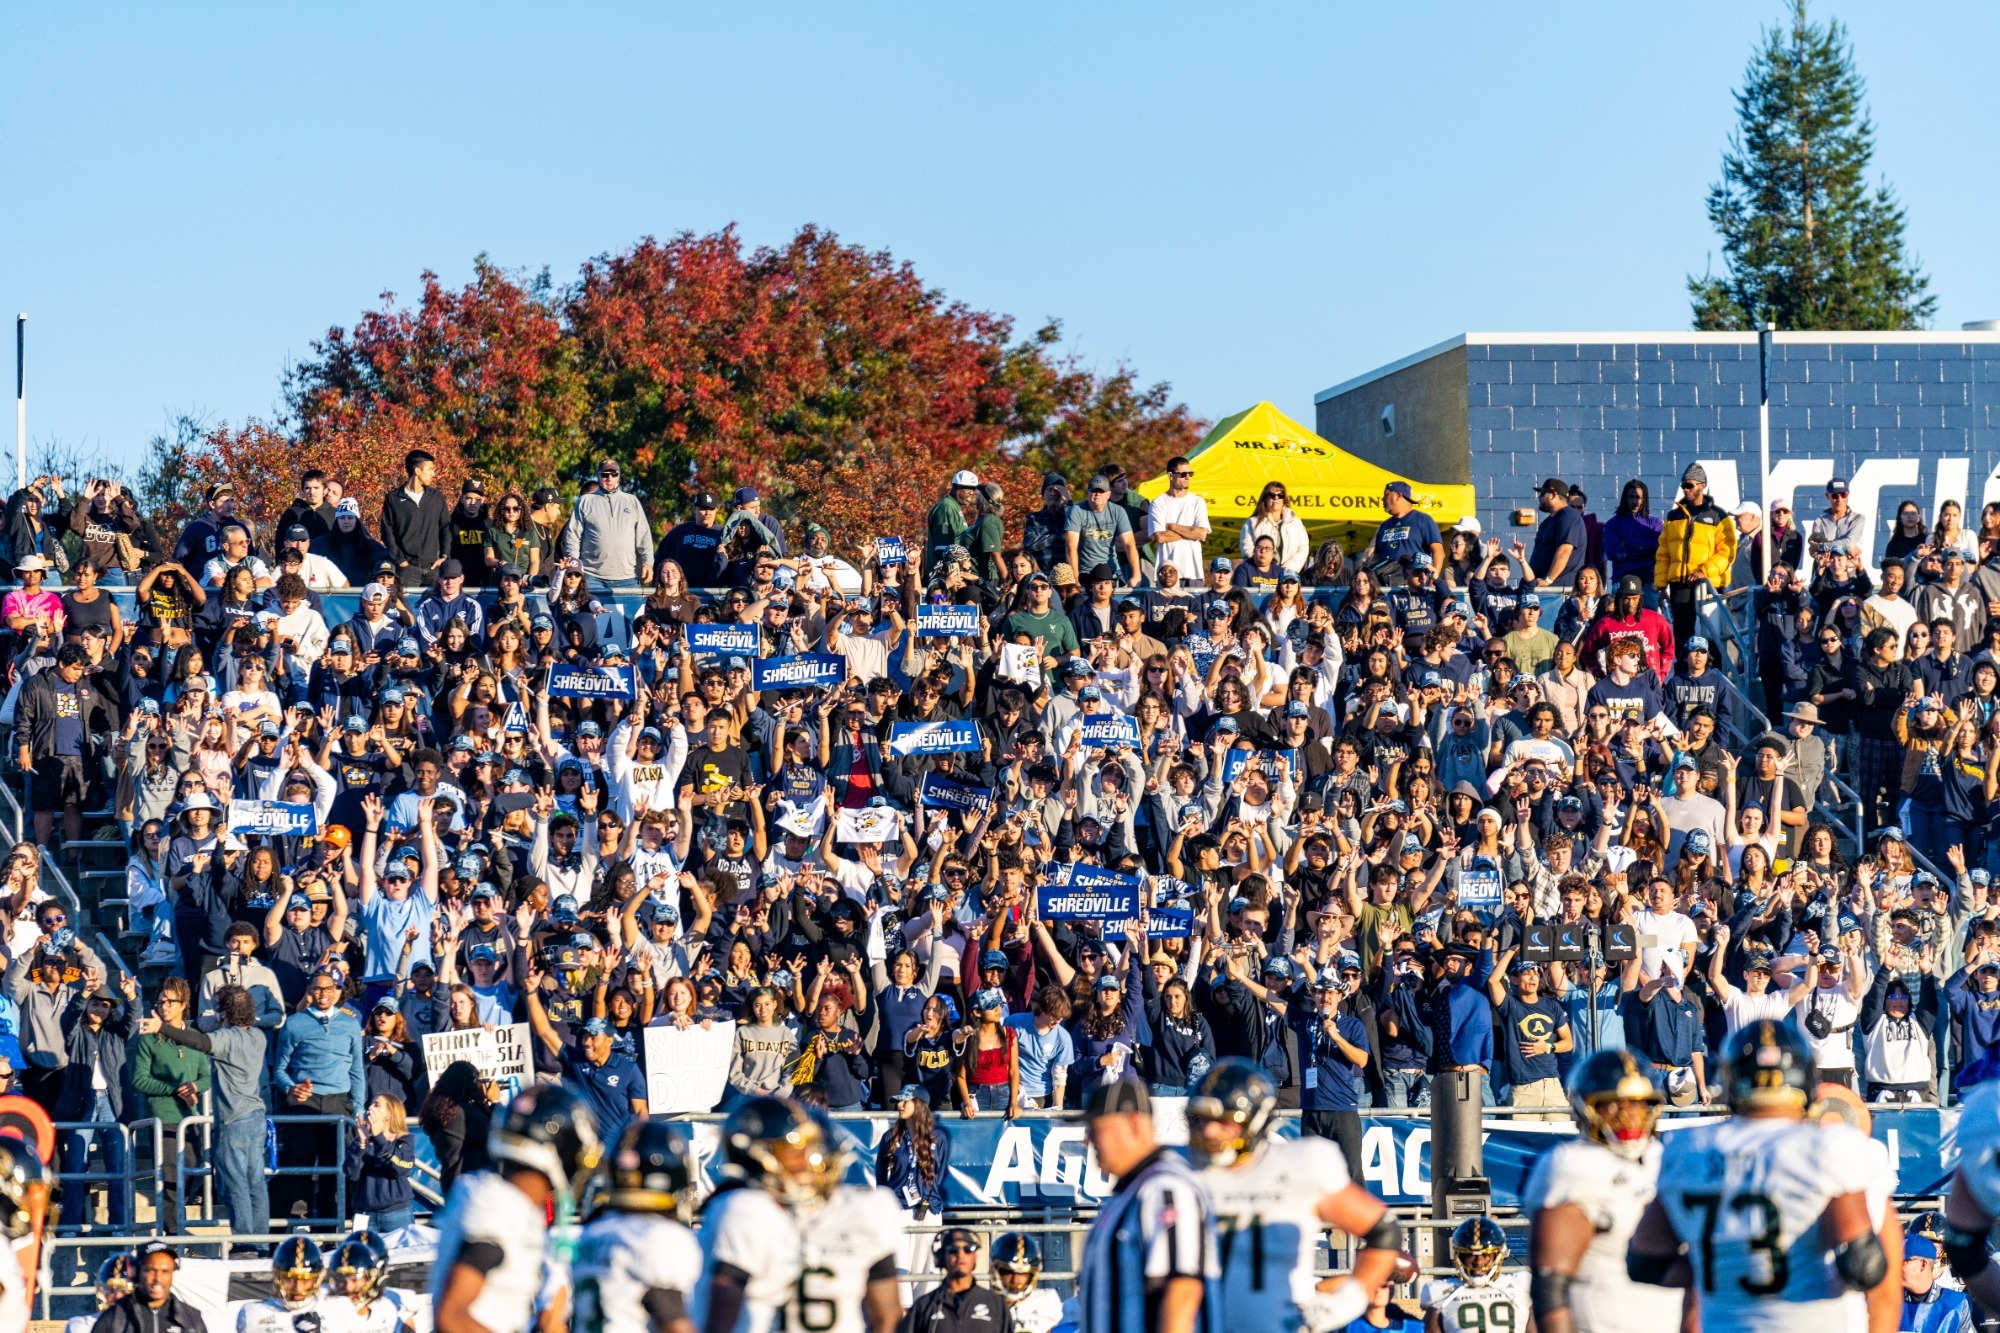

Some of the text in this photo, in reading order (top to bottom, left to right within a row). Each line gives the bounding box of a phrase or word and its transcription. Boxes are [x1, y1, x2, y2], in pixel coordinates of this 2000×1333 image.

[1234, 495, 1325, 508] CAMEL
[458, 530, 485, 545] CAT
[762, 662, 838, 684] SHREDVILLE
[553, 674, 629, 693] SHREDVILLE
[897, 731, 972, 748] SHREDVILLE
[1047, 897, 1131, 913] SHREDVILLE
[429, 1027, 515, 1053] PLENTY OF
[741, 1040, 790, 1059] UC DAVIS
[496, 1044, 526, 1063] SEA
[1682, 1190, 1788, 1295] 73
[1457, 1301, 1516, 1333] 99
